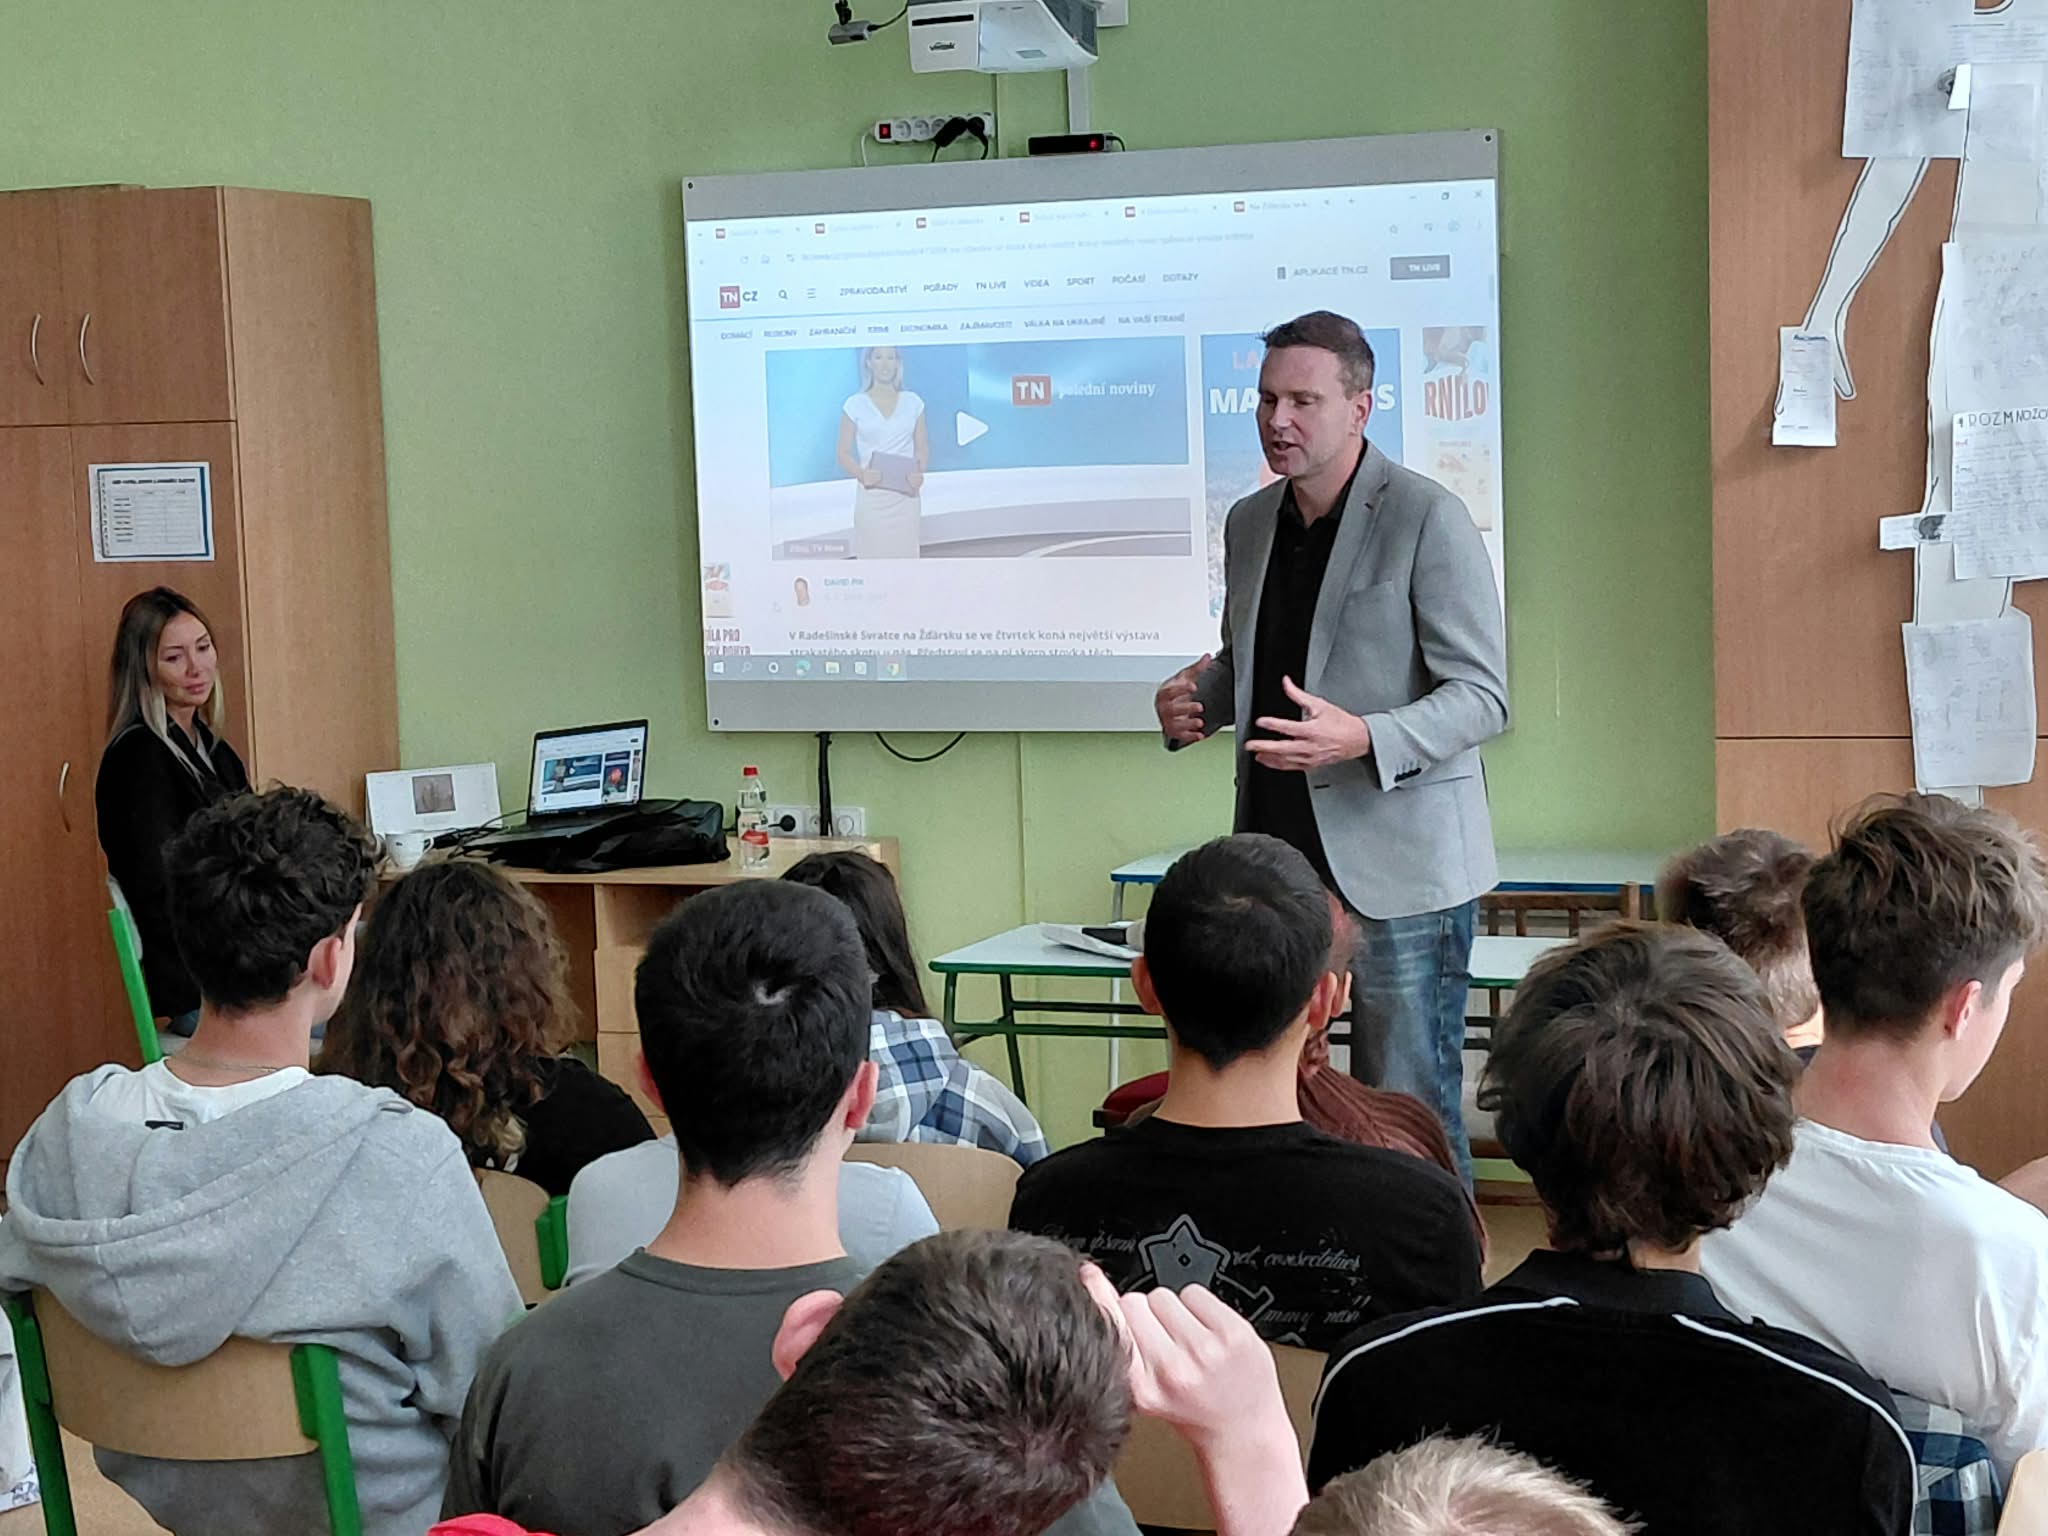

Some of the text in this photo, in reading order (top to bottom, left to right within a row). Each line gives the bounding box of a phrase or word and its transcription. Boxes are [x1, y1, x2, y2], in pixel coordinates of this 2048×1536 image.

[1066, 277, 1095, 286] SPORT
[1016, 381, 1045, 400] TN
[1110, 380, 1157, 397] noviny
[861, 630, 900, 641] Svratce
[903, 631, 916, 641] na
[965, 632, 977, 641] se
[980, 632, 993, 641] ve
[996, 629, 1034, 641] čtvrtek
[1038, 629, 1066, 641] koná
[1115, 629, 1161, 641] výstava
